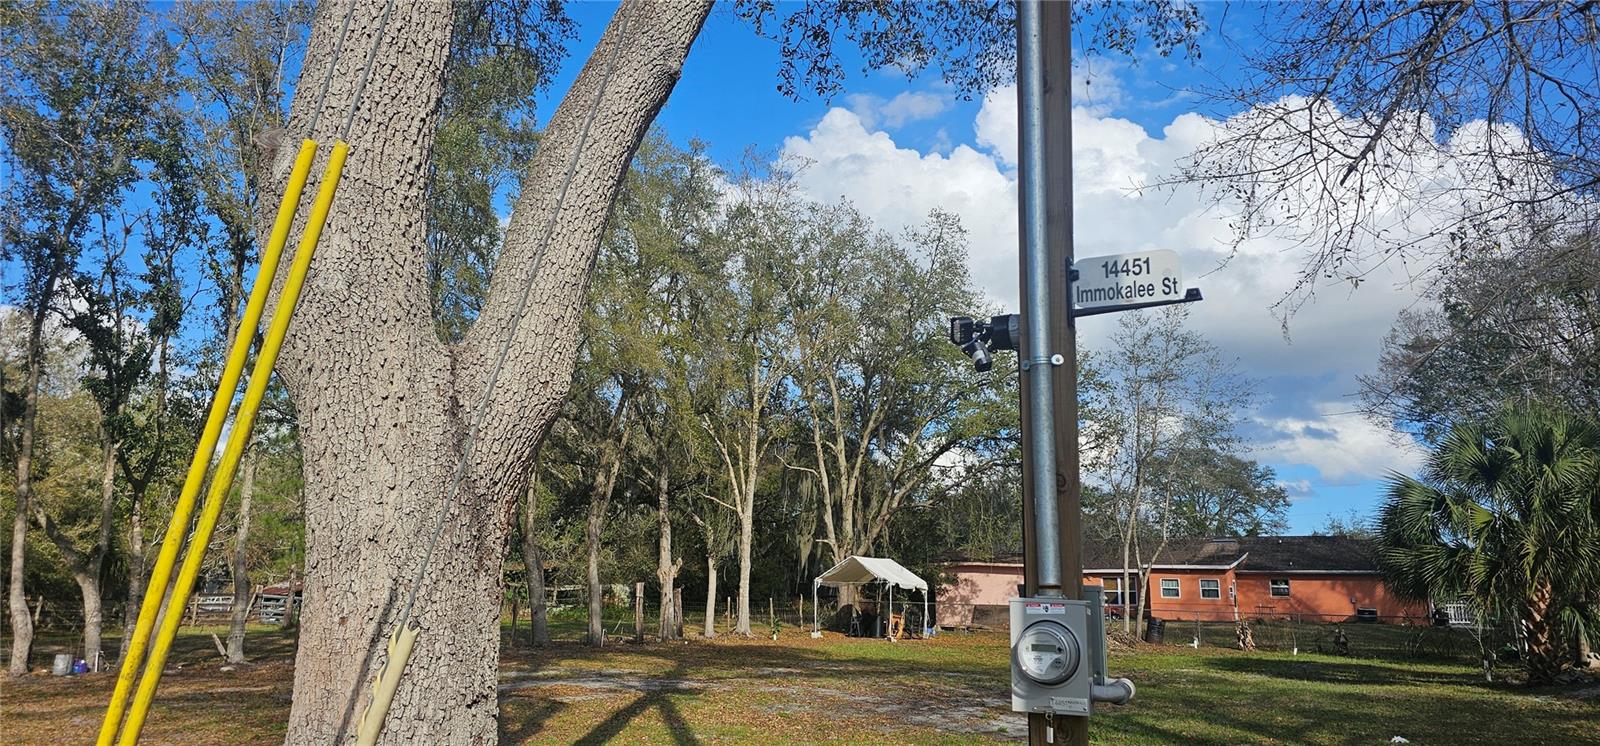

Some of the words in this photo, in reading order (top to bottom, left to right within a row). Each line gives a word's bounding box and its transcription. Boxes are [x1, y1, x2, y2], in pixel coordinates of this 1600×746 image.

[1102, 257, 1150, 278] 14451
[1077, 281, 1154, 303] Immokalee
[1162, 277, 1178, 295] St
